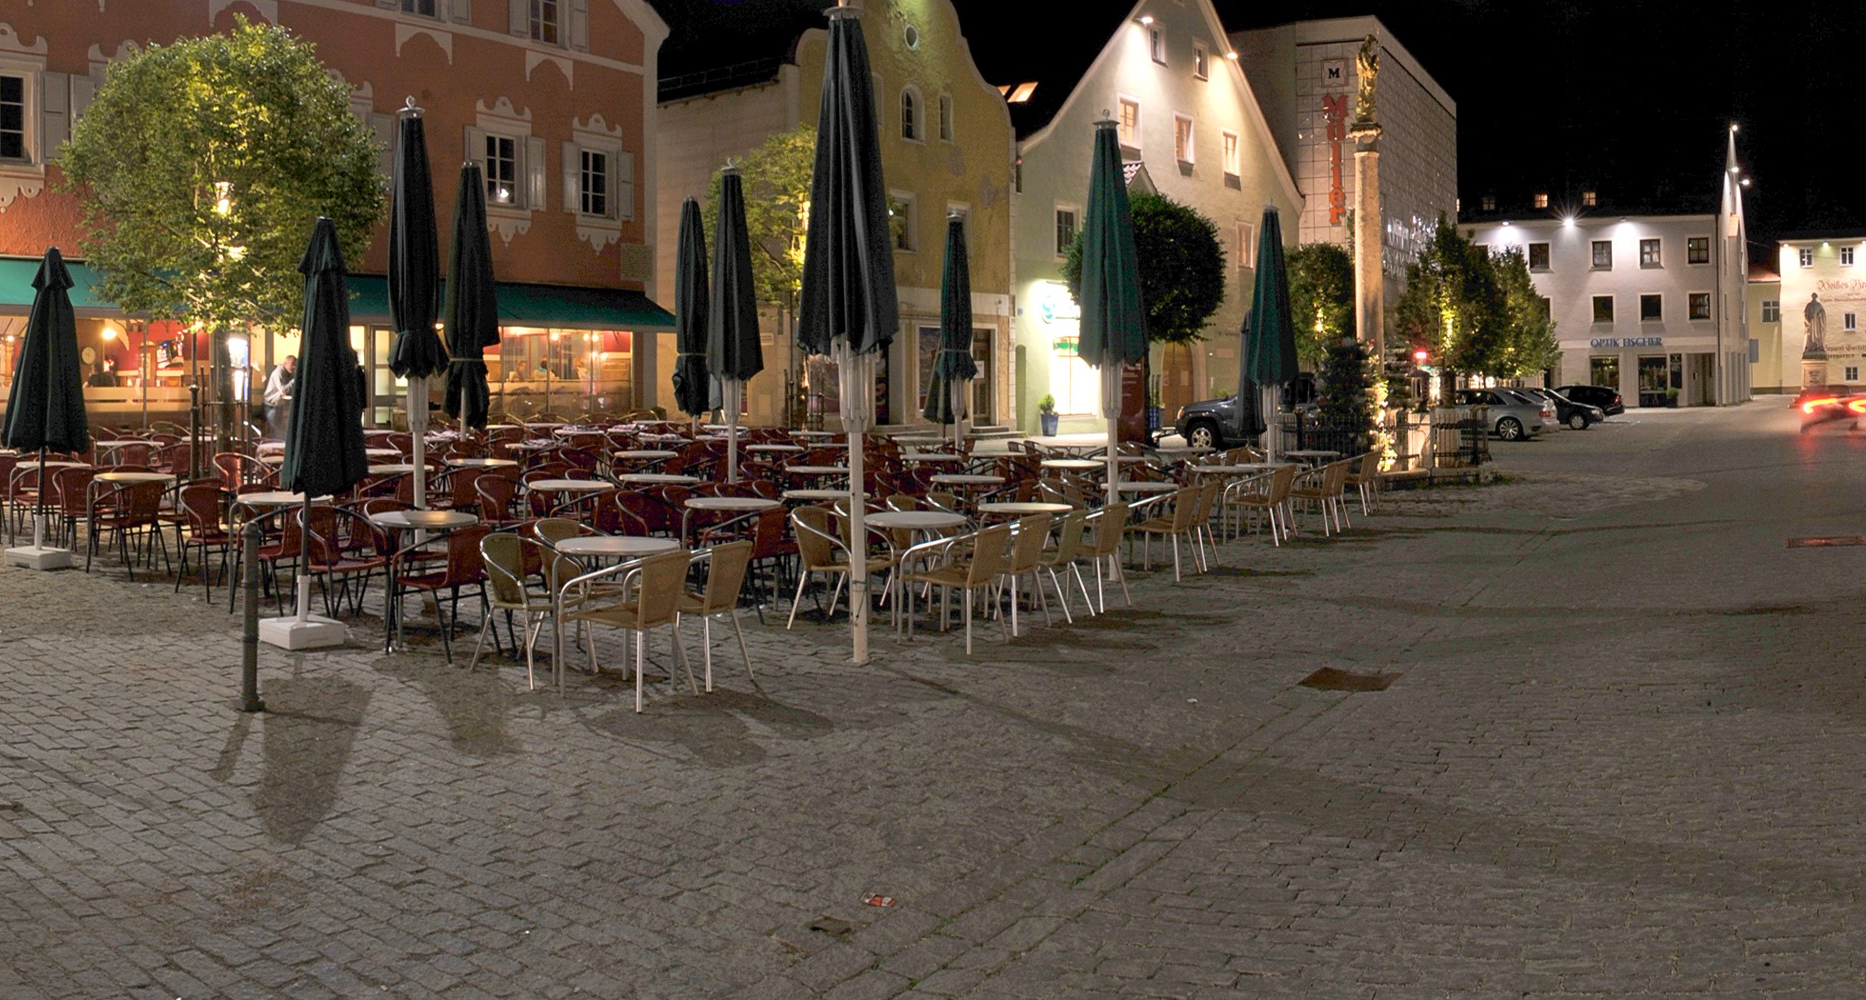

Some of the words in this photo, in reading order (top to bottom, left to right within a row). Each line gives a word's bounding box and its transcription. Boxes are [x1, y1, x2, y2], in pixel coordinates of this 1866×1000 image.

[1328, 67, 1340, 79] M
[1590, 338, 1620, 348] OPTIK
[1622, 337, 1662, 347] FISCHER
